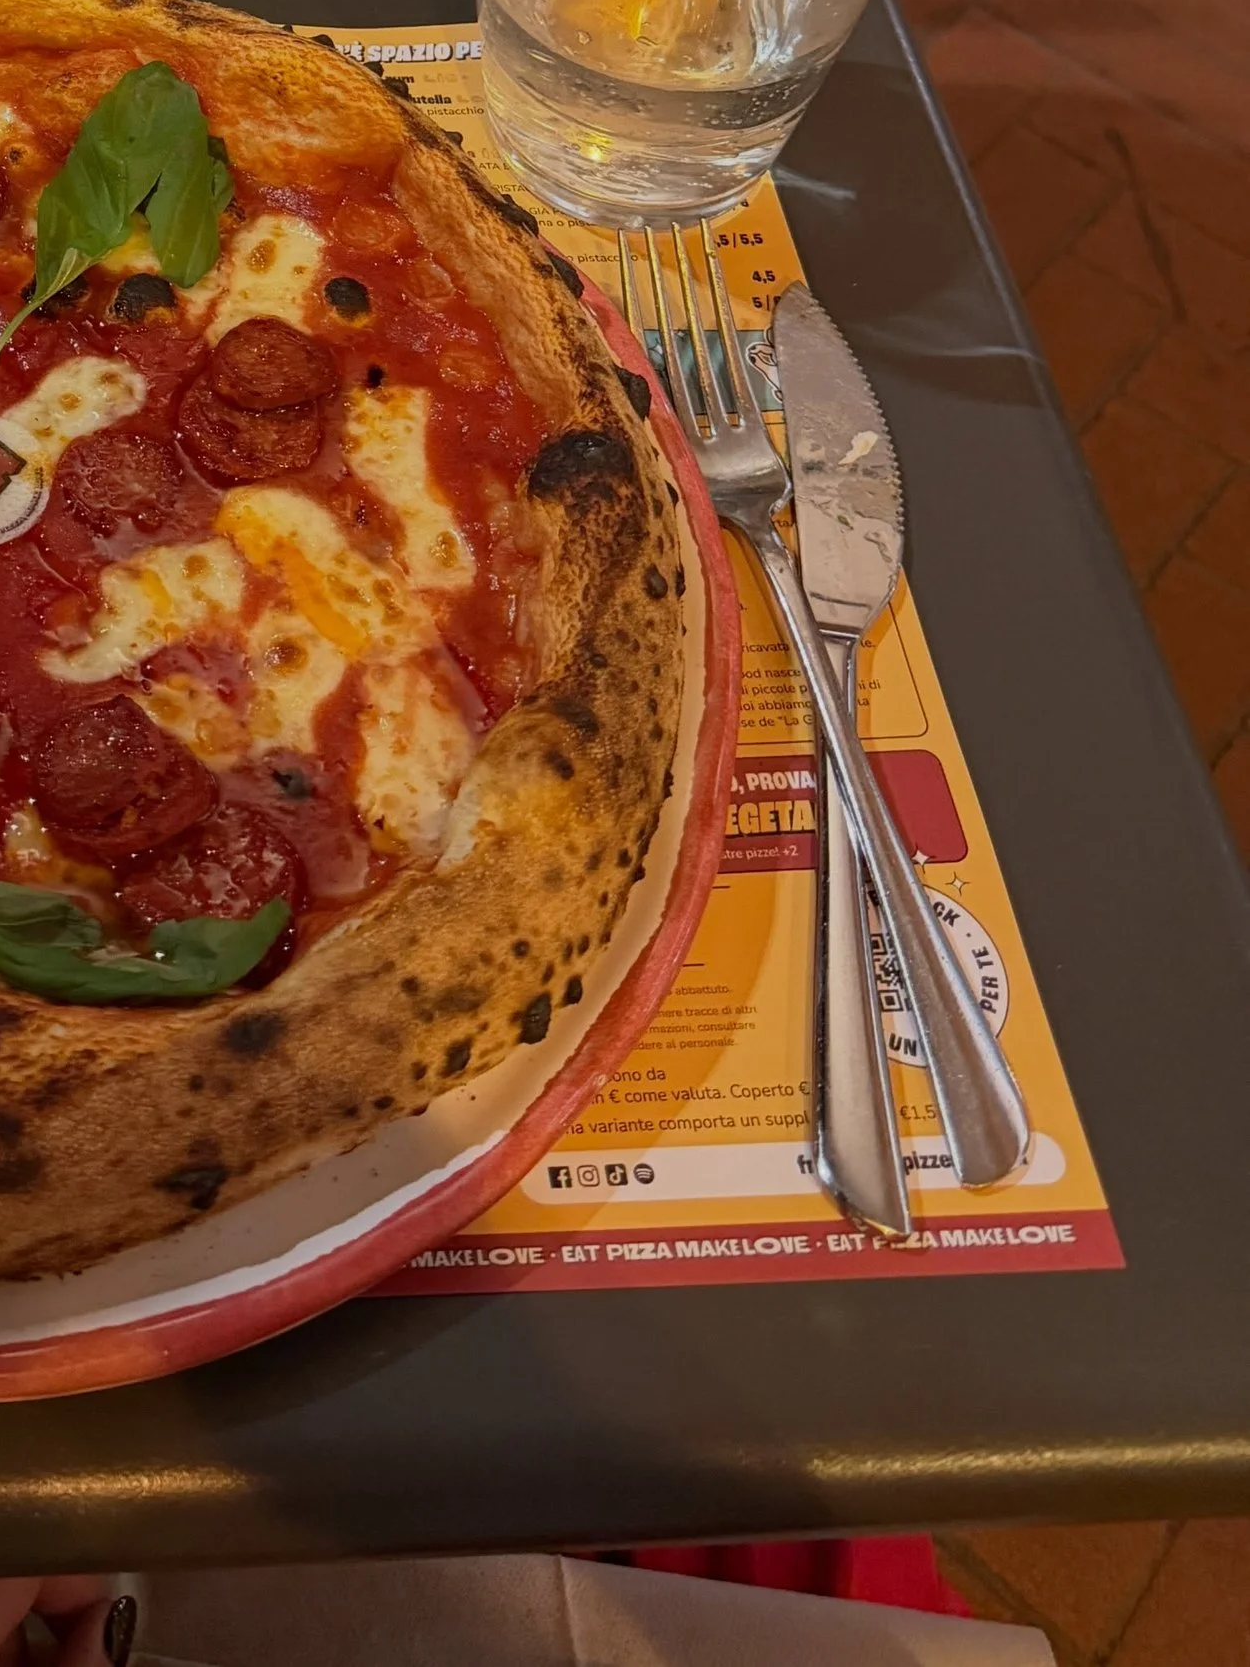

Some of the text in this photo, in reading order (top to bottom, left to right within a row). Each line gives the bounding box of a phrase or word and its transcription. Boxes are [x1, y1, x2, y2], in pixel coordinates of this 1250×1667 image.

[365, 40, 484, 64] SPAZIO PE
[409, 94, 452, 105] utella
[427, 106, 485, 116] pistacchio
[752, 270, 776, 284] 4,5
[888, 1032, 918, 1057] UN
[971, 945, 995, 970] TE
[646, 1067, 666, 1080] da
[624, 1091, 667, 1103] come
[671, 1086, 726, 1100] valuta.
[730, 1083, 794, 1101] Coperto
[588, 1110, 811, 1134] variante comporta un suppl
[561, 1244, 600, 1263] EAT
[606, 1241, 673, 1262] PIZZA
[826, 1233, 866, 1254] EAT
